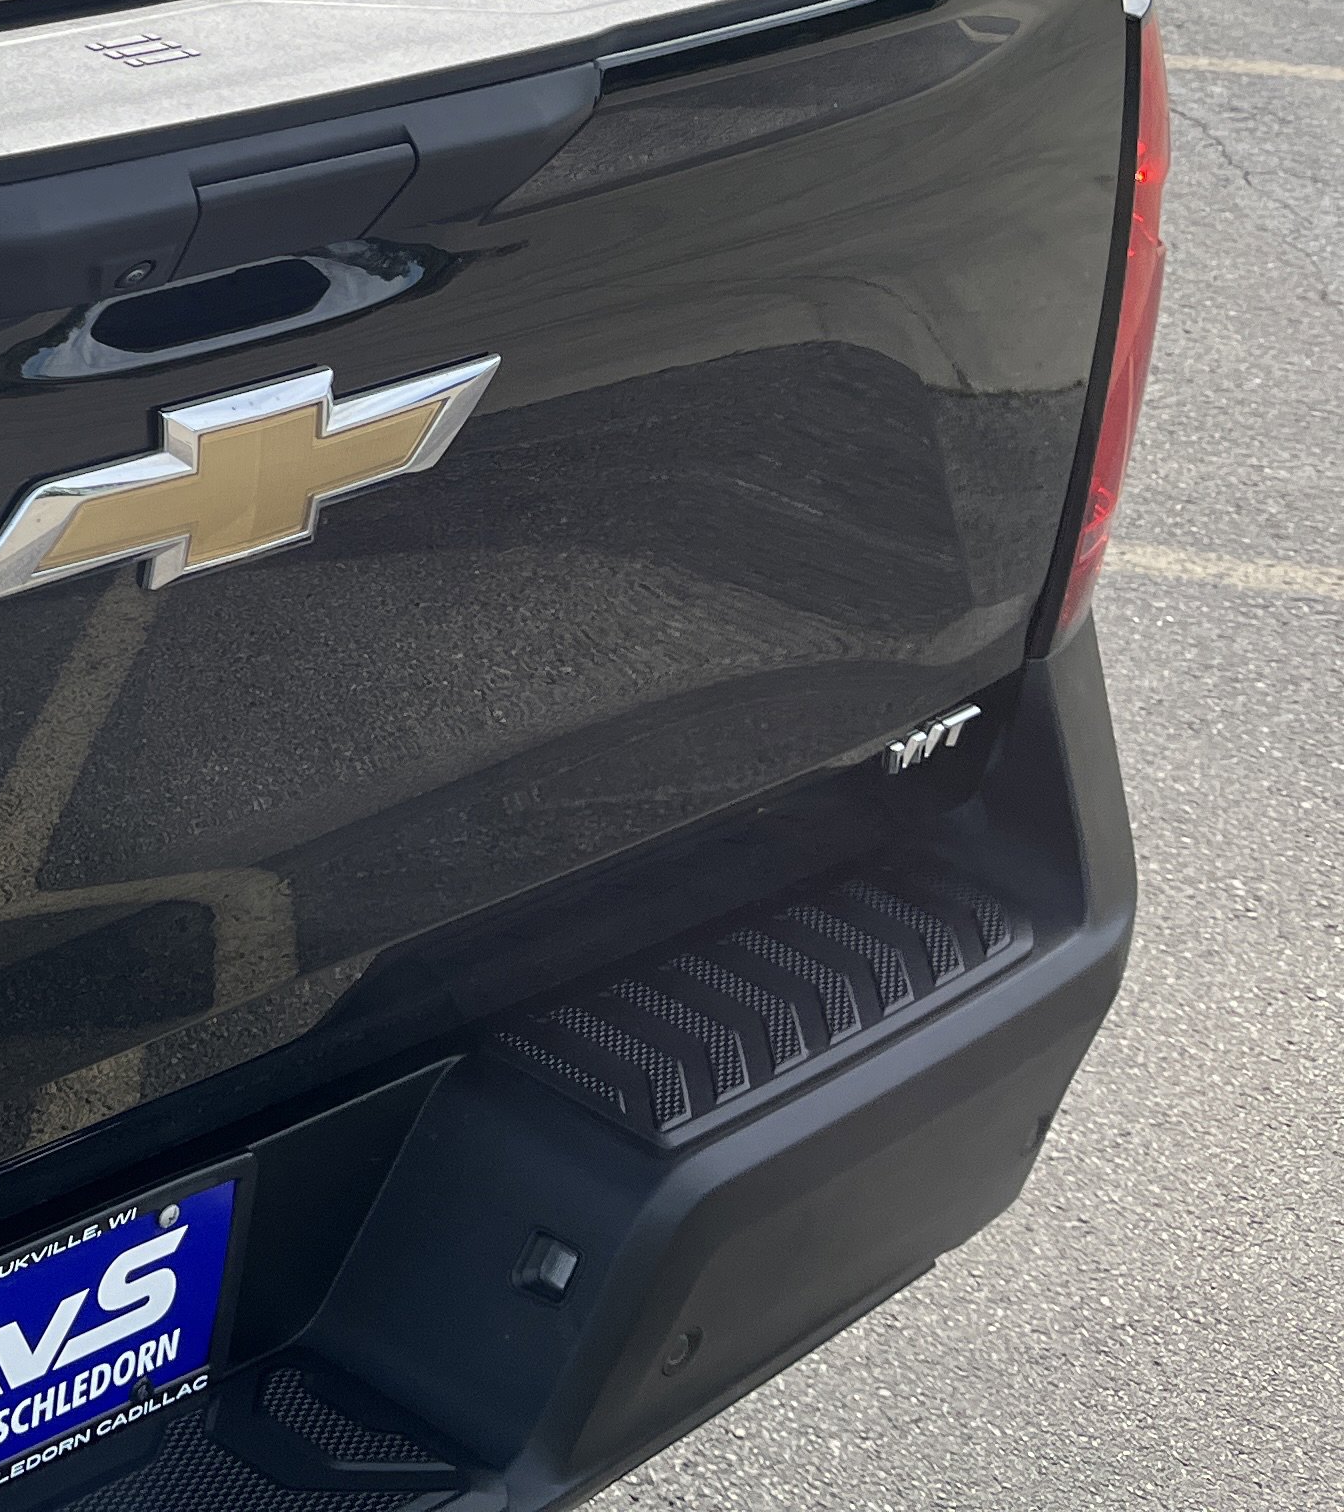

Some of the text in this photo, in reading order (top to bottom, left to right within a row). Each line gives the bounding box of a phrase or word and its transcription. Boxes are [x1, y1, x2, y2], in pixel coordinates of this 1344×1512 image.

[881, 703, 982, 774] WT
[109, 1207, 137, 1230] WI
[96, 1375, 209, 1437] CADILLAC
